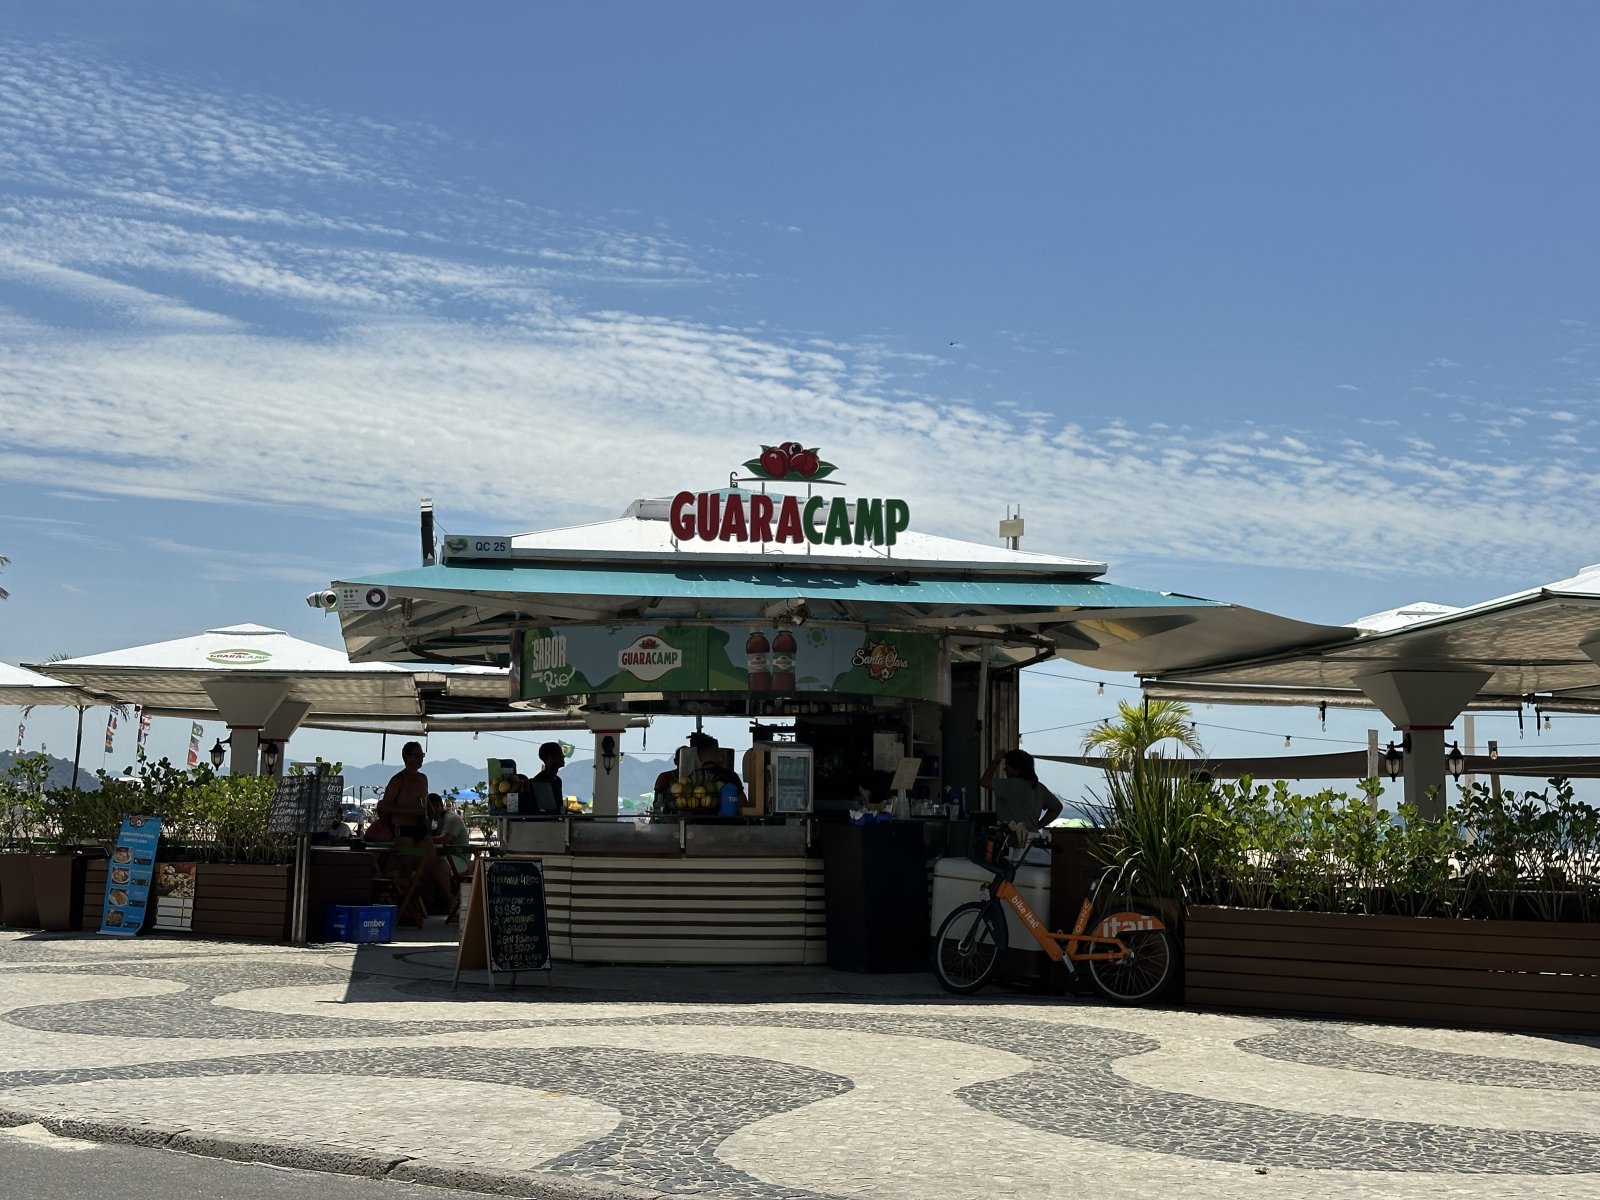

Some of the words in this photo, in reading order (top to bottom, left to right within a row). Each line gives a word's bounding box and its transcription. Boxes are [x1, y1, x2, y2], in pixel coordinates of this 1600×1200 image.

[670, 490, 911, 546] GUARACAMP
[475, 541, 491, 552] QC
[493, 541, 506, 552] 25
[532, 635, 567, 671] SABOR
[621, 651, 679, 666] GUARACAMP
[852, 648, 885, 666] Santa
[885, 650, 909, 669] Clara
[543, 666, 576, 692] Rio
[1011, 895, 1026, 914] bike
[363, 919, 386, 928] ambev
